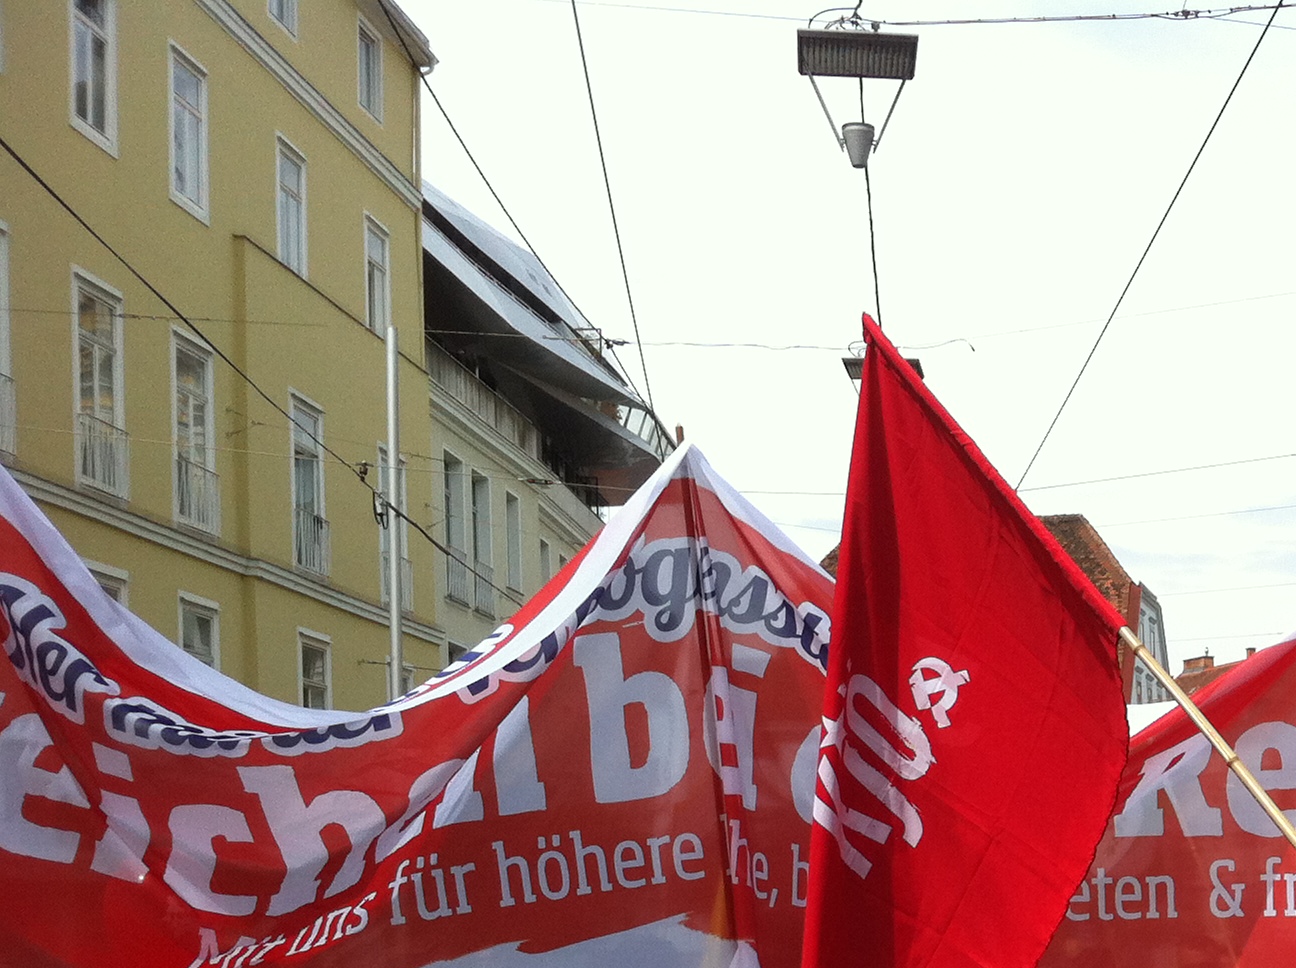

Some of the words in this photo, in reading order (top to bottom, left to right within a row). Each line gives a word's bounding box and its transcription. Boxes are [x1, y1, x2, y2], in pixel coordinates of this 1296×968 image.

[285, 893, 377, 957] uns
[390, 852, 476, 926] für
[492, 830, 706, 908] höhere
[1064, 865, 1178, 922] eten
[1209, 858, 1246, 919] &
